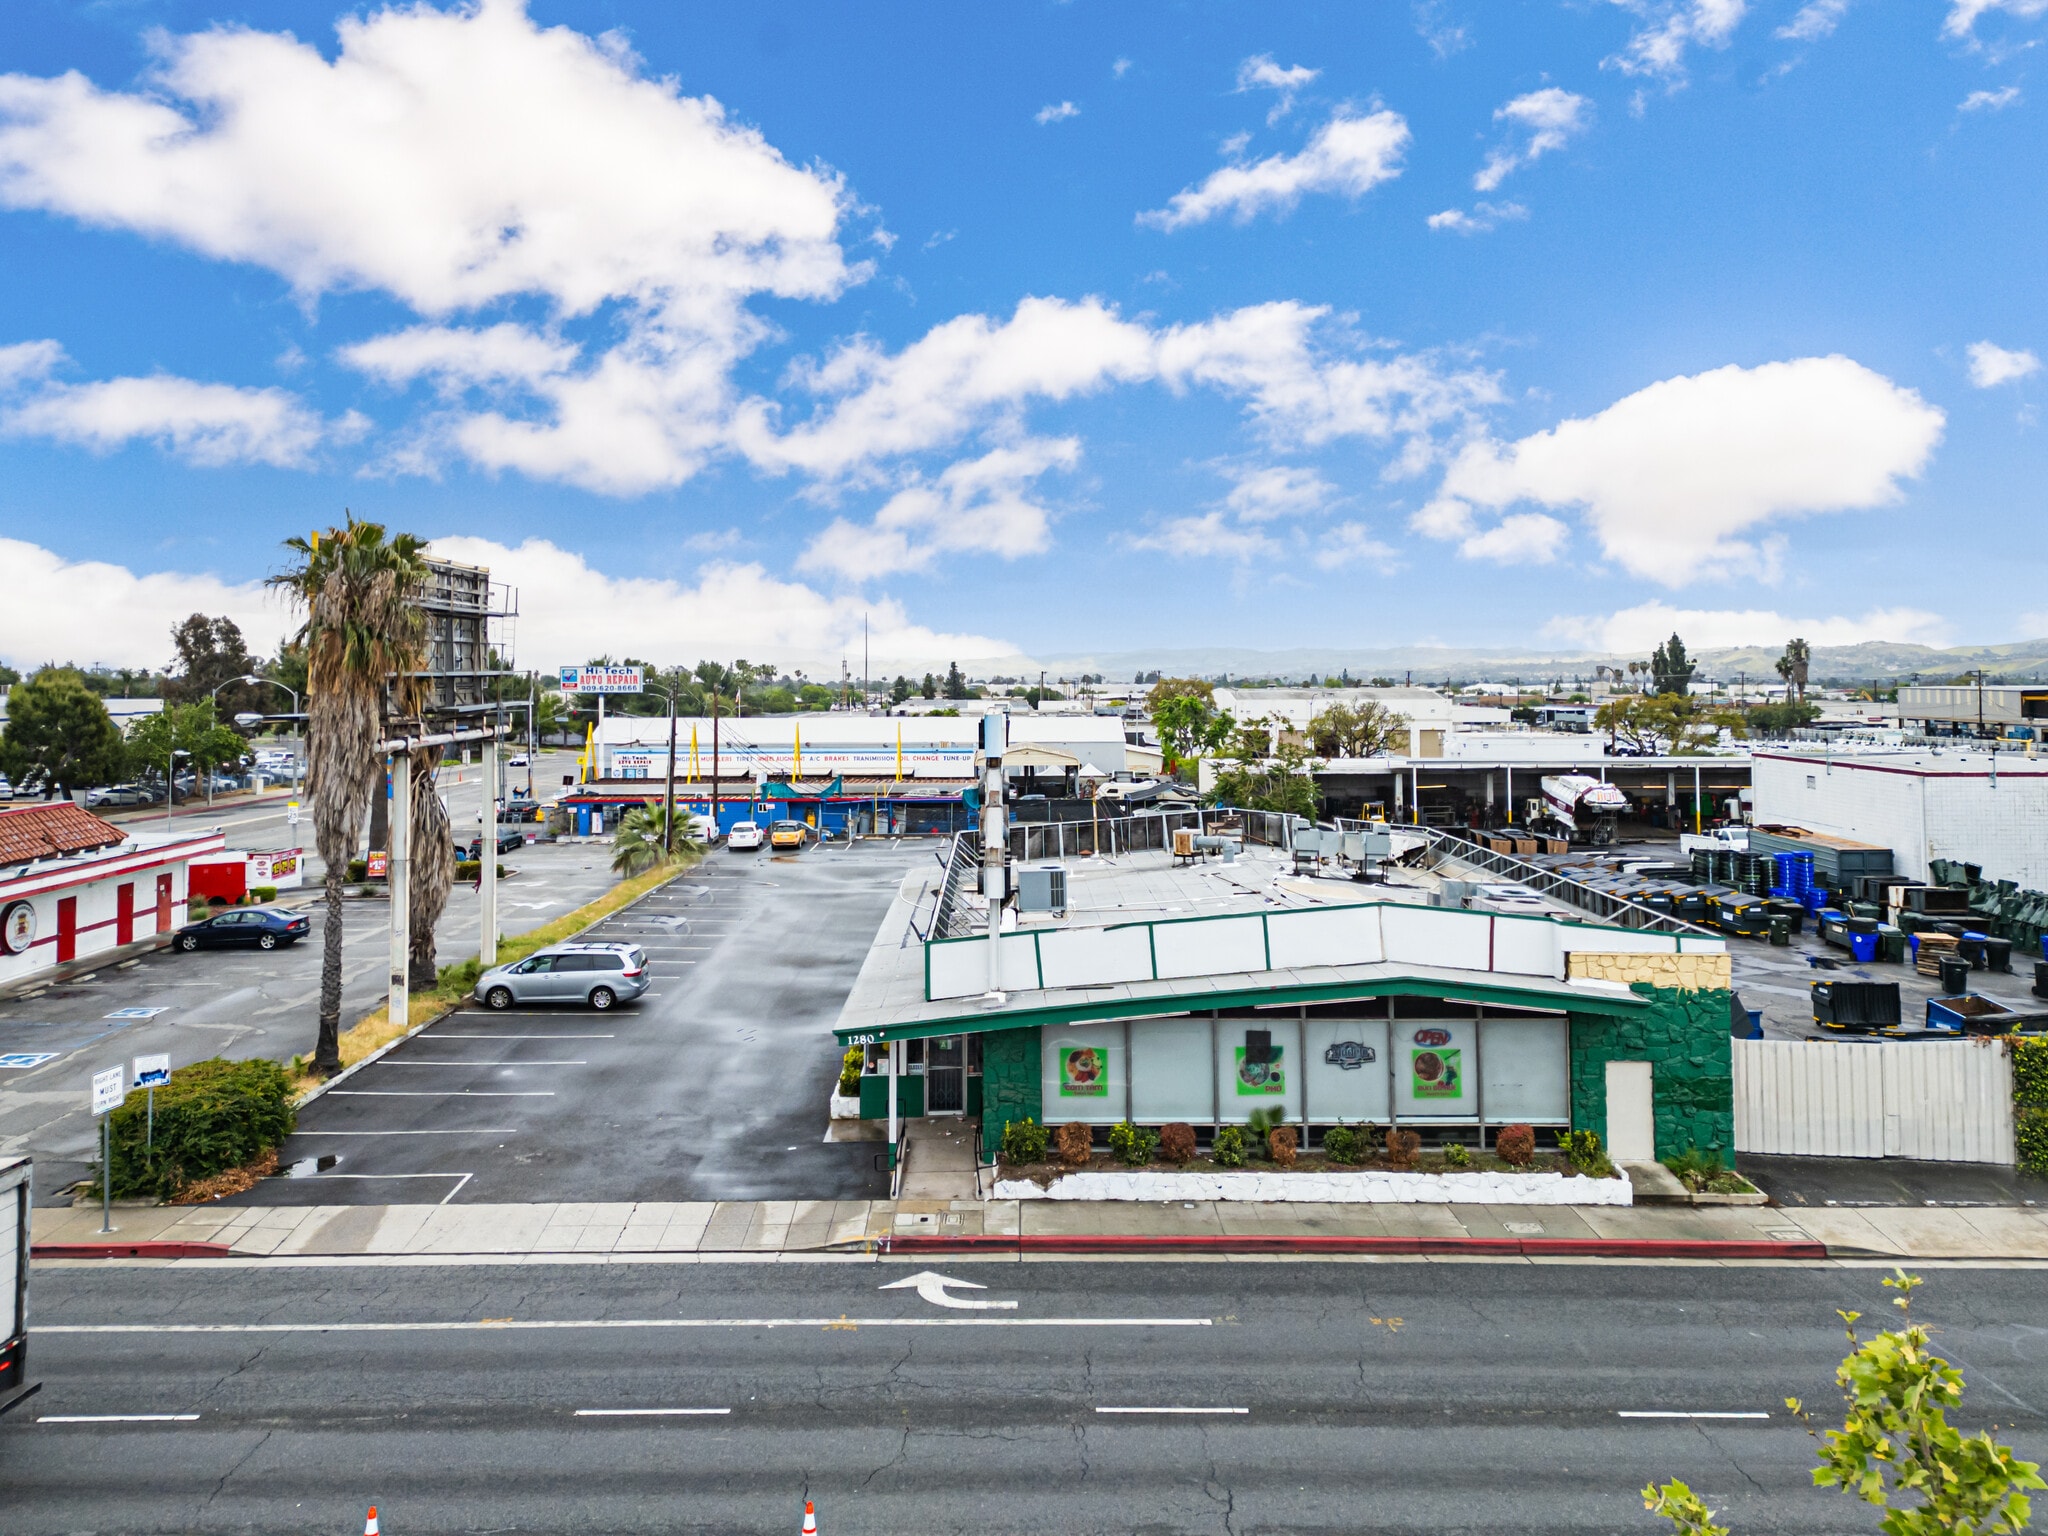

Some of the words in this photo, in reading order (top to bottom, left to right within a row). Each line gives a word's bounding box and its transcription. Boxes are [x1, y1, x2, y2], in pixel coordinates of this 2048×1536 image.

[586, 667, 633, 675] Hi-Tech
[580, 675, 602, 684] AUTO
[607, 675, 638, 684] REPAIR
[848, 1034, 874, 1045] 1280
[1414, 1030, 1449, 1046] OPEN
[110, 1070, 122, 1080] LANE
[99, 1082, 117, 1095] MUST
